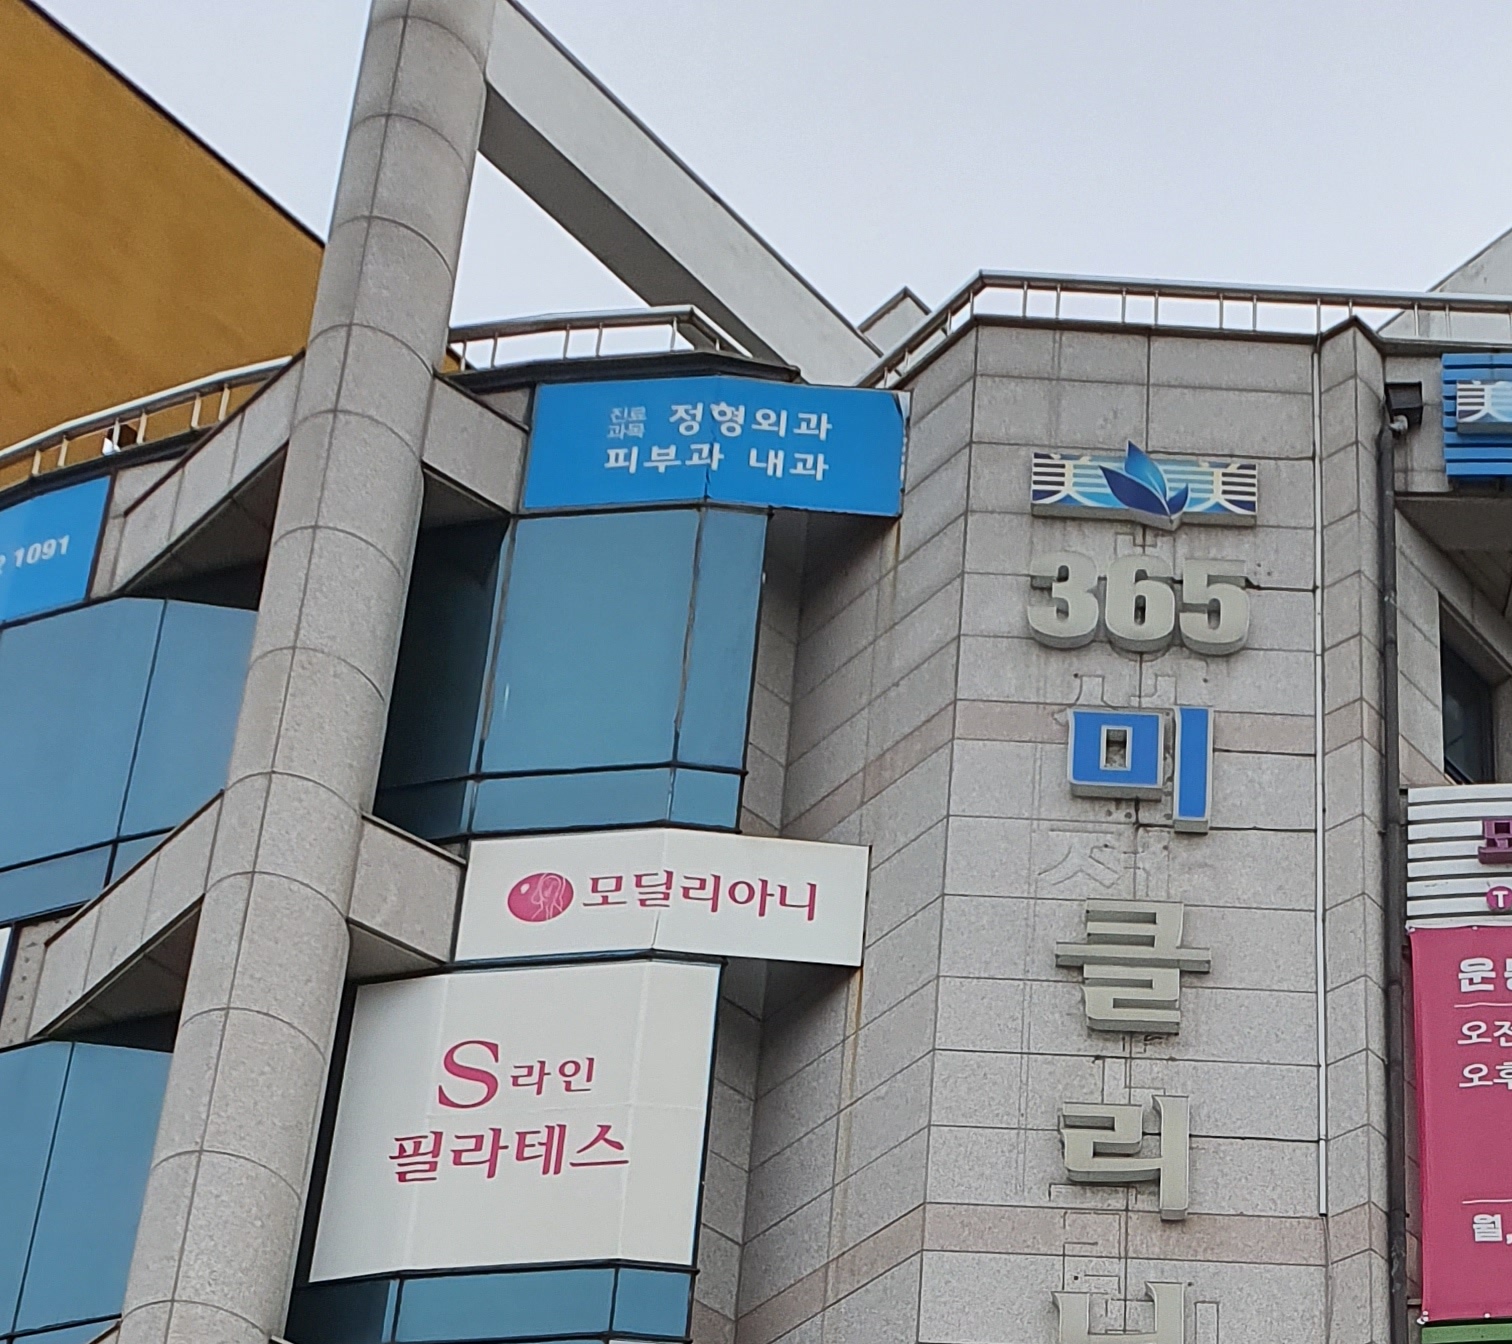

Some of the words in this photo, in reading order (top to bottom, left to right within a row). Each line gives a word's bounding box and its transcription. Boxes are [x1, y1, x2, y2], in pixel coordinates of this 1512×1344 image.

[669, 402, 833, 441] 정형외과
[604, 442, 725, 474] 피부과
[749, 447, 829, 481] 내과
[14, 534, 70, 568] 1091
[1028, 549, 1251, 655] 365
[581, 868, 818, 922] 모딜리아니
[388, 1121, 631, 1184] 필라테스
